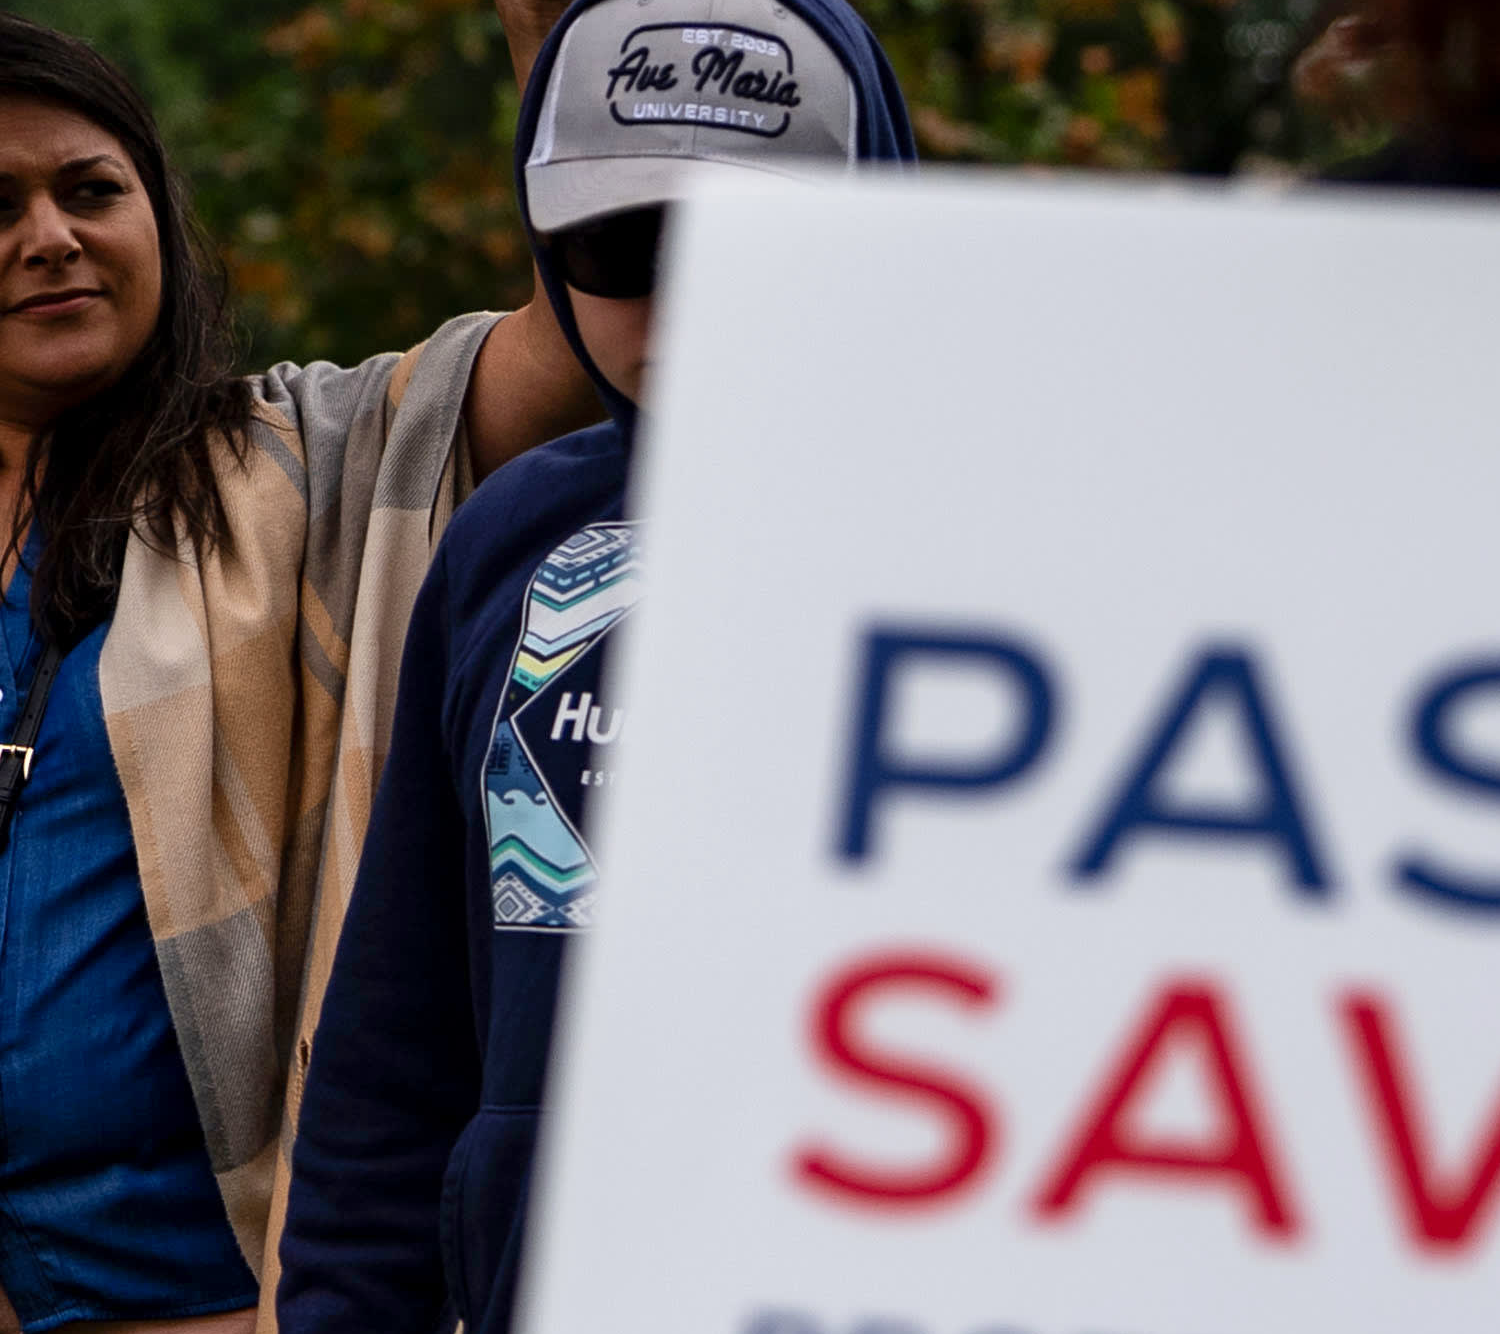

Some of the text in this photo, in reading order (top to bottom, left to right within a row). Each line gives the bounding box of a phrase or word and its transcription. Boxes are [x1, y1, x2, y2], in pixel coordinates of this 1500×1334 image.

[606, 45, 802, 108] Ave Maria
[632, 101, 767, 128] UNIVERSITY
[550, 692, 625, 745] Hu
